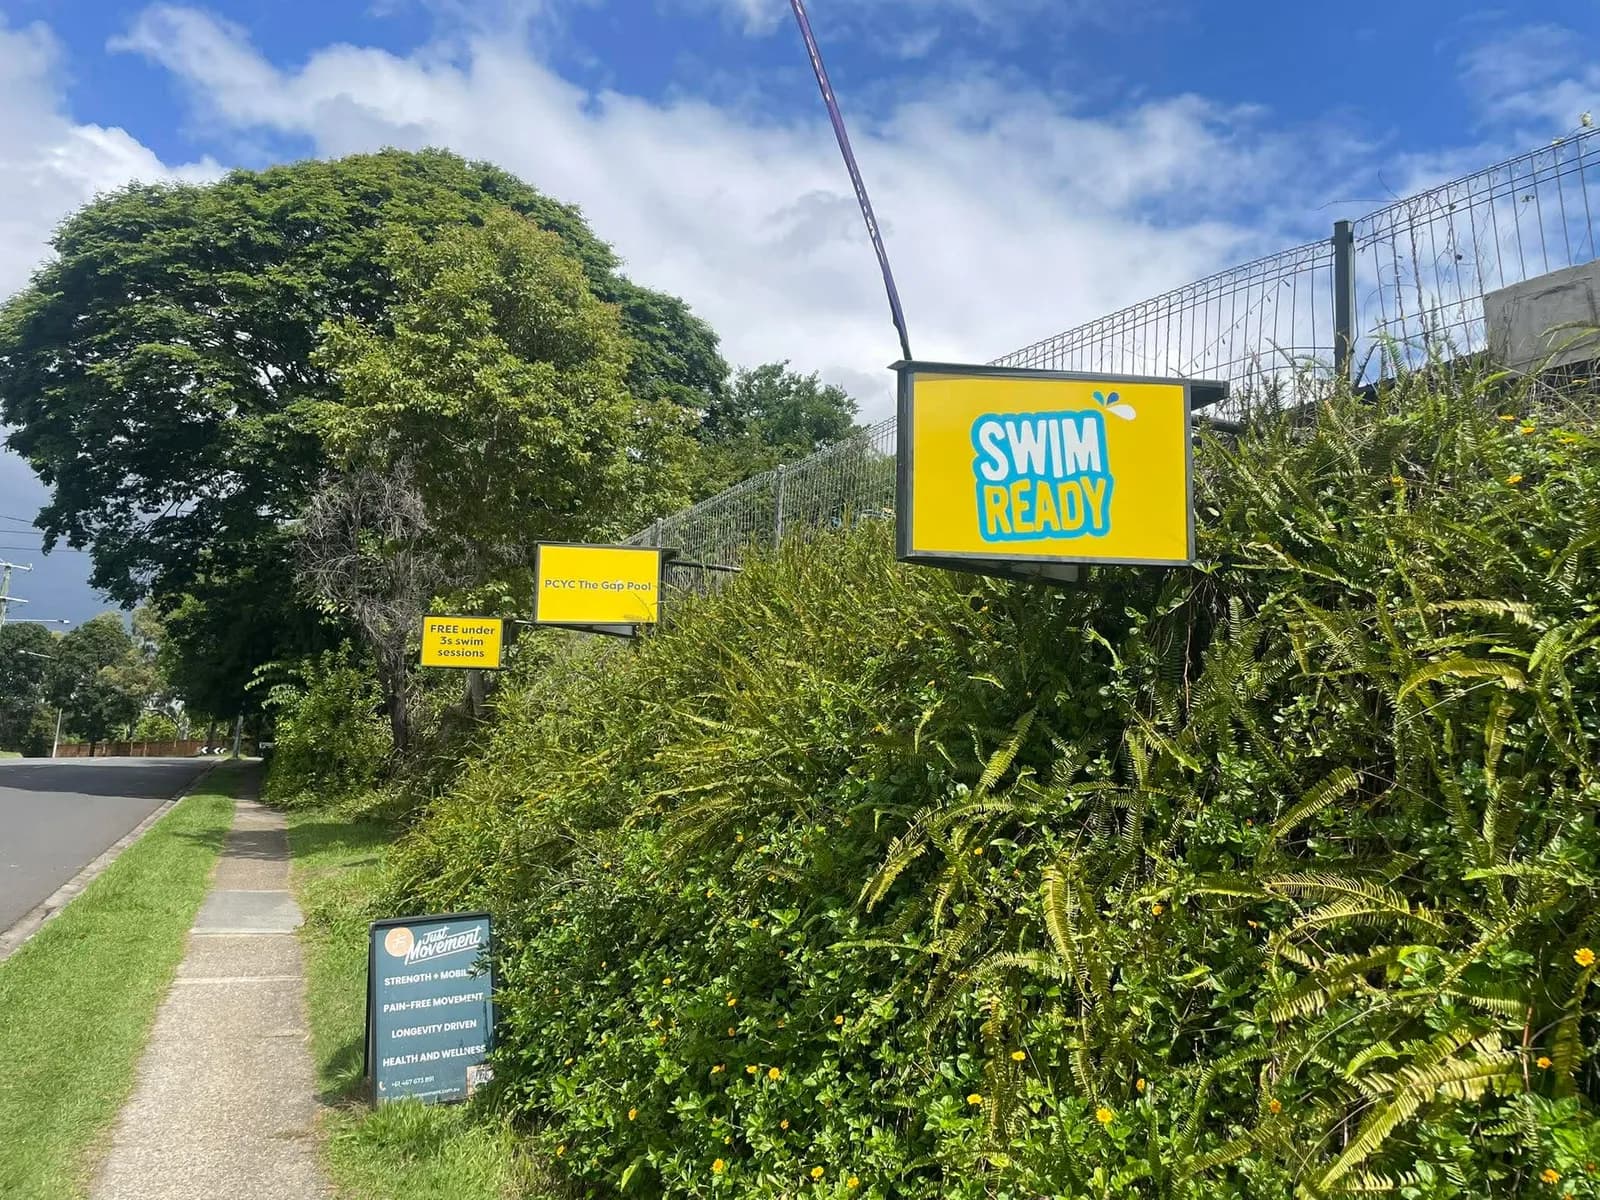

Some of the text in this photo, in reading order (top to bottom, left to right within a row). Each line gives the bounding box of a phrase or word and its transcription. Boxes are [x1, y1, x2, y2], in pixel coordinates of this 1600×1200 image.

[979, 417, 1102, 481] SWIM
[983, 476, 1107, 535] READY
[545, 579, 652, 592] PCYC The Gap Pool
[430, 624, 496, 635] FREE under
[440, 636, 484, 646] 3s swim
[437, 647, 485, 658] sessions
[422, 926, 450, 944] Just
[404, 926, 483, 965] Movement
[384, 973, 432, 986] STRENGTH
[440, 967, 482, 979] MOBIL
[383, 992, 485, 1013] PAIN-FREE MOVEMENT
[391, 1019, 477, 1039] LONGEVITY DRIVEN
[383, 1044, 487, 1067] HEALTH AND WELLNESS
